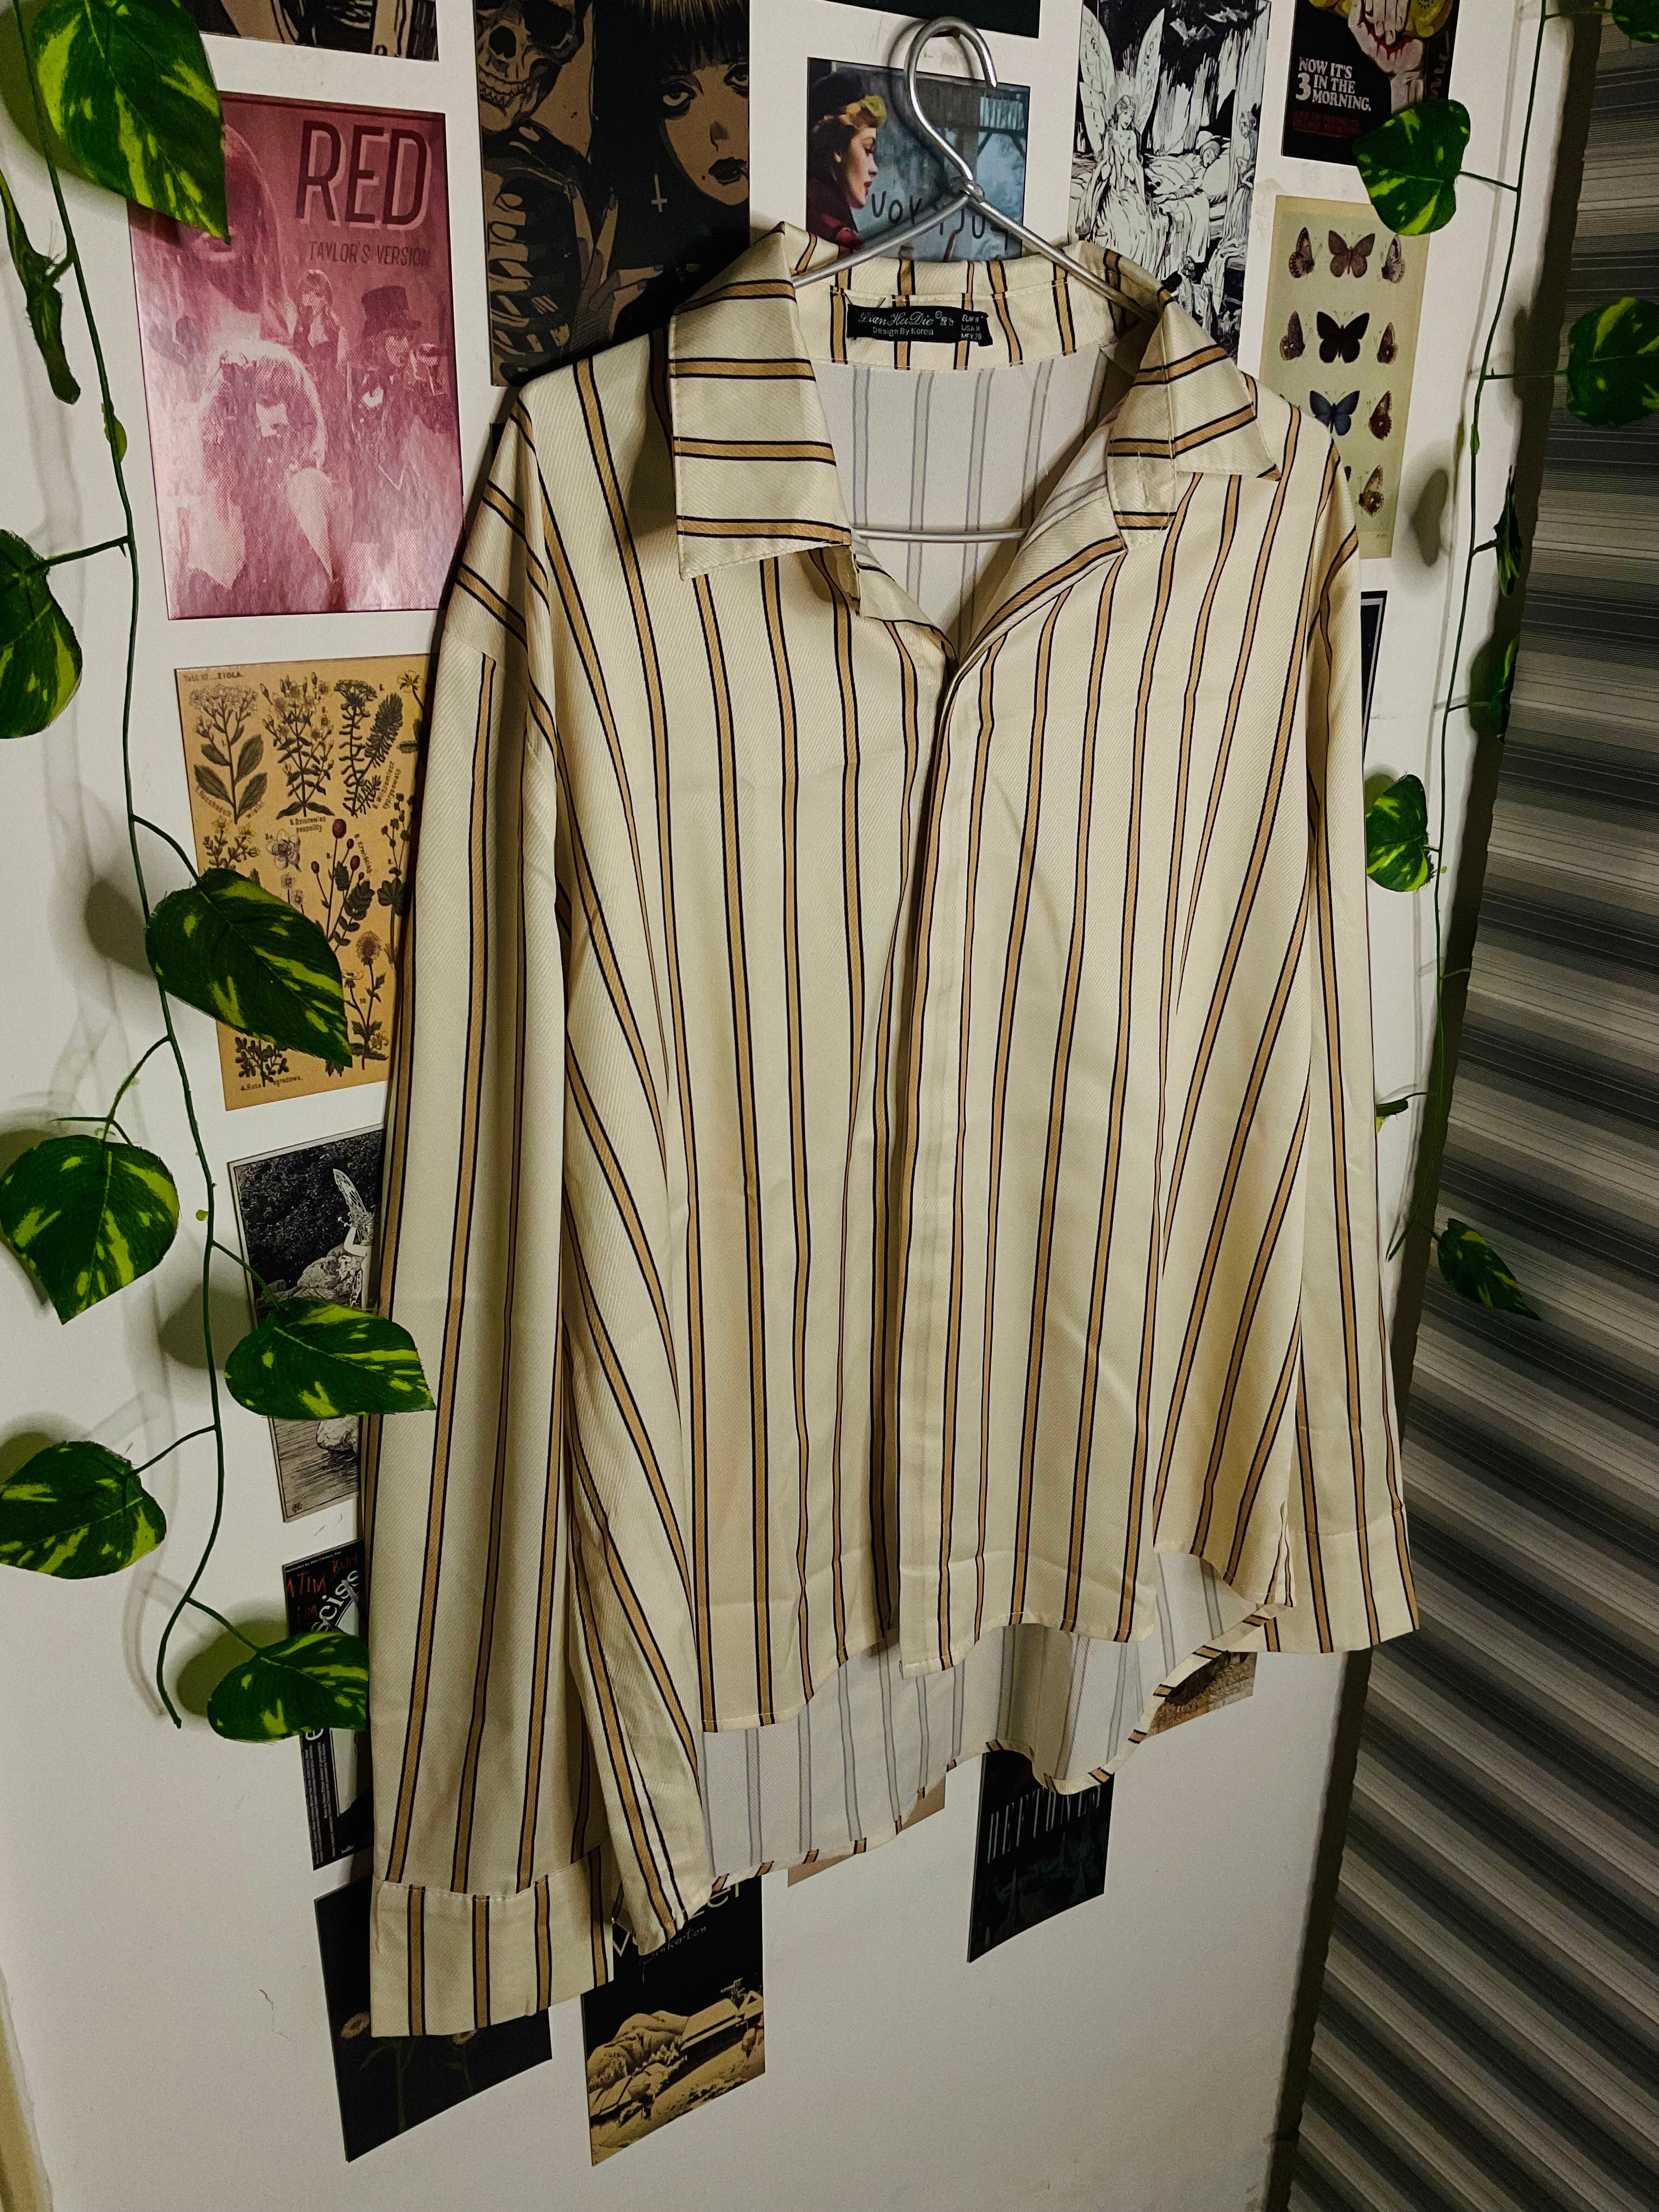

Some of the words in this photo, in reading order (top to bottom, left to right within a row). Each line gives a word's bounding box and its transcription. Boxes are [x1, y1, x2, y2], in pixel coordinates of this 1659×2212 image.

[1299, 57, 1328, 75] NOW
[1330, 63, 1352, 79] IT'S
[1295, 72, 1311, 100] 3
[1313, 74, 1328, 89] IN
[1330, 77, 1356, 94] THE
[1312, 88, 1372, 111] MORNING.
[296, 120, 431, 229] RED
[309, 240, 370, 264] TAYLOR'S
[376, 245, 431, 267] VERSION
[872, 326, 899, 336] Design
[900, 328, 910, 336] By
